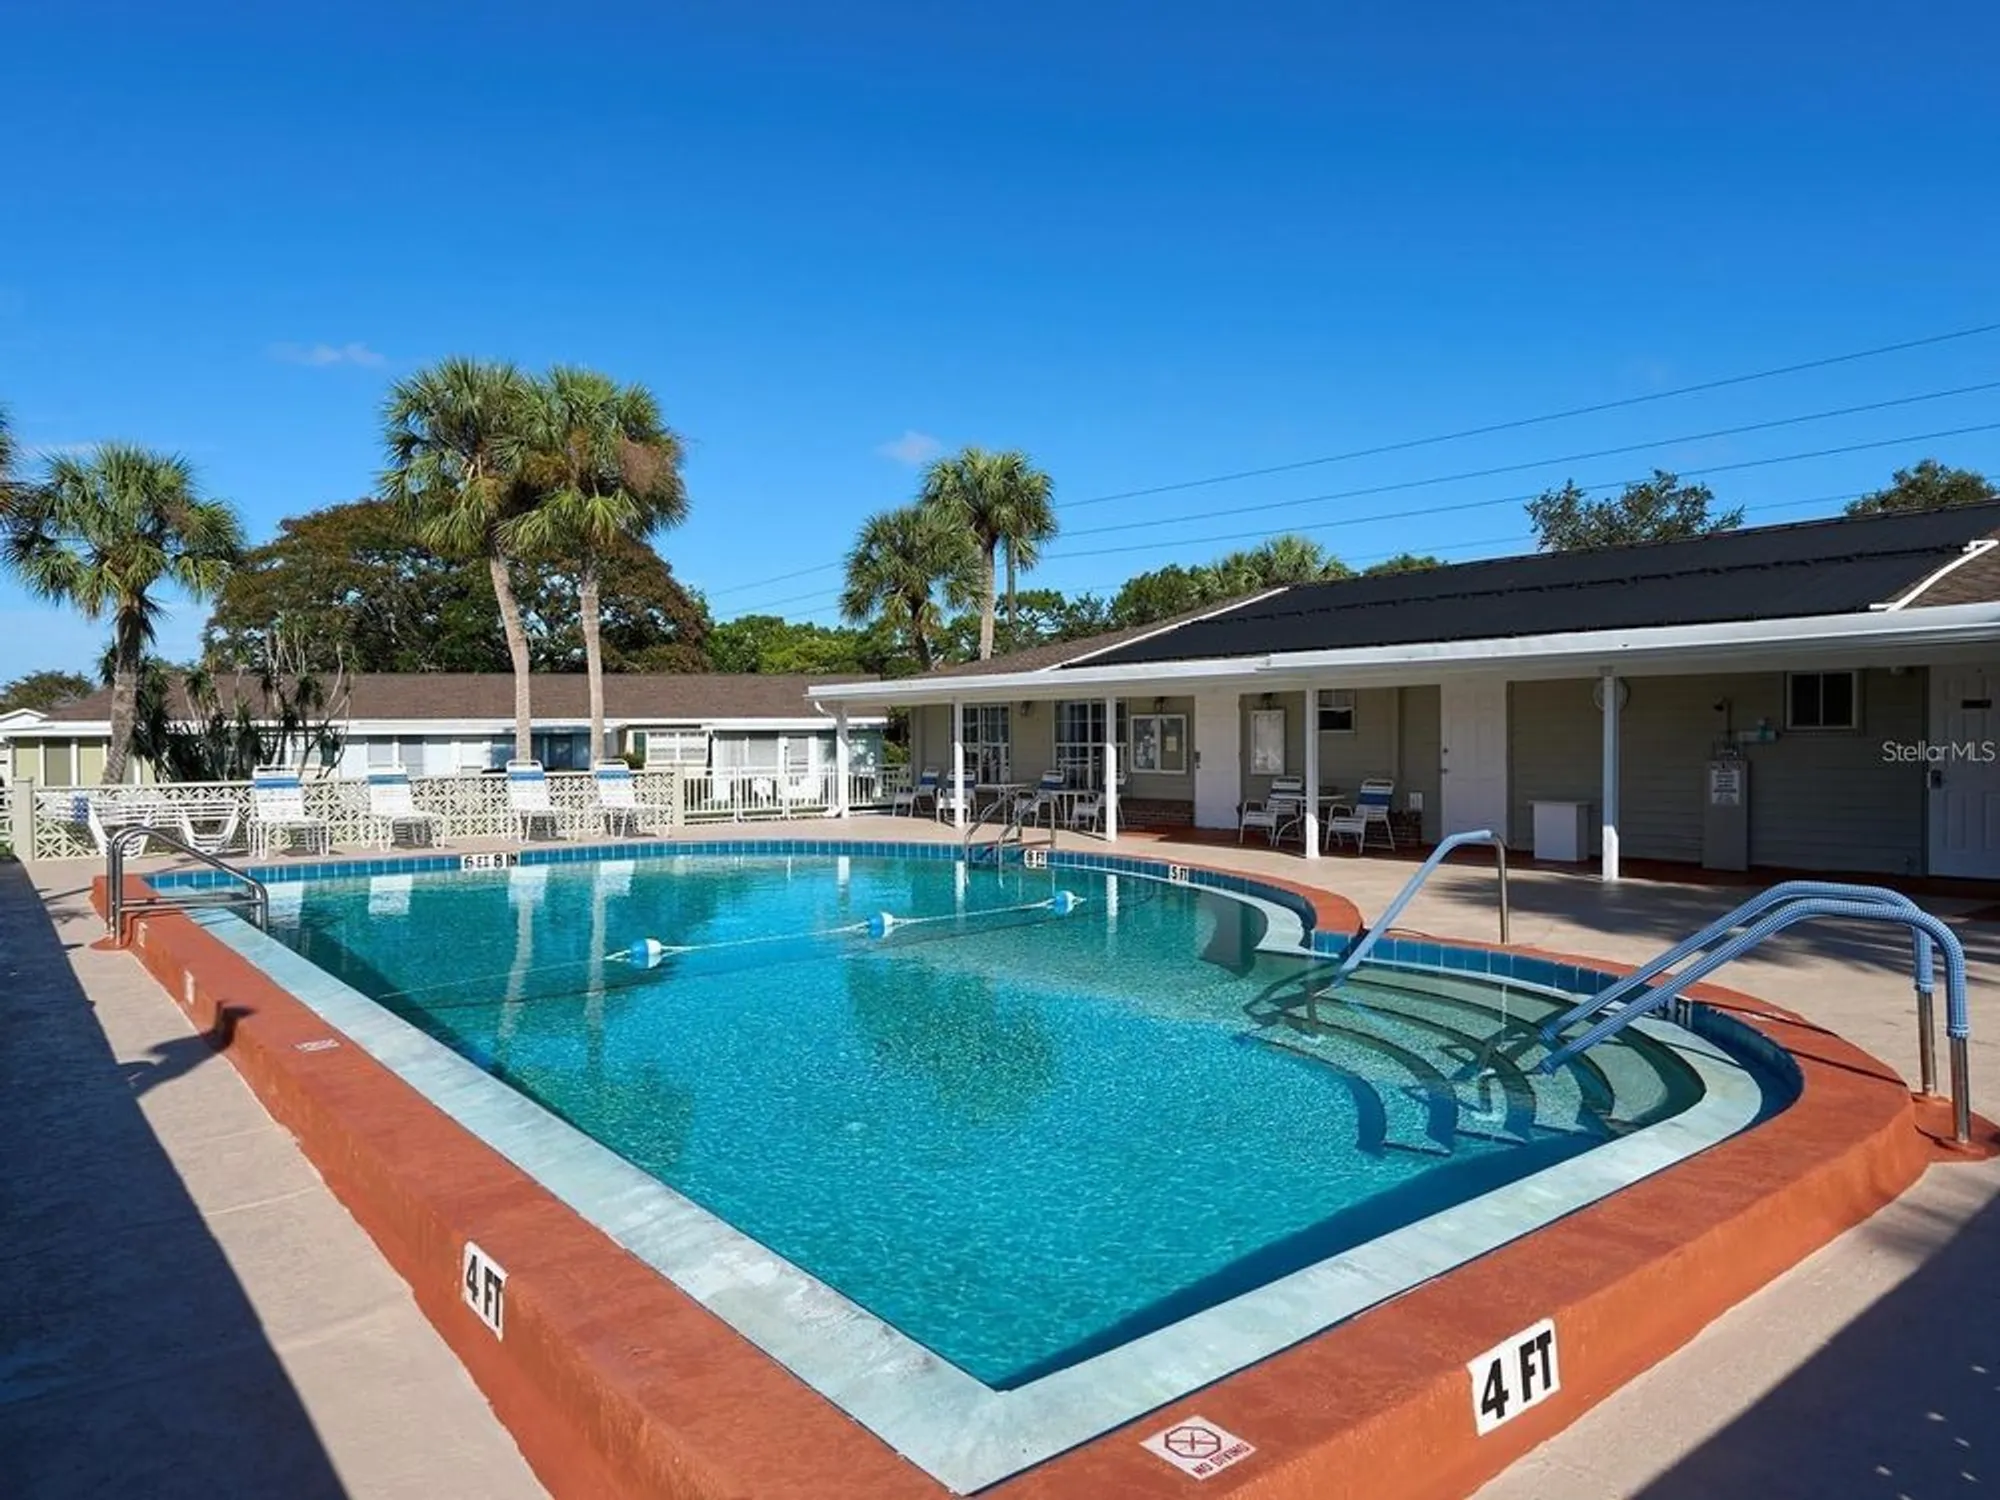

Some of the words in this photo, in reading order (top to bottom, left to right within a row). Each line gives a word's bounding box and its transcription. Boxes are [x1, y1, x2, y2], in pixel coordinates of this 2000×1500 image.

[466, 1254, 479, 1303] 4
[484, 1266, 503, 1328] FT
[1481, 1357, 1509, 1419] 4
[1519, 1329, 1552, 1403] FT
[1192, 1462, 1213, 1475] NO
[1209, 1443, 1250, 1466] DIVING
